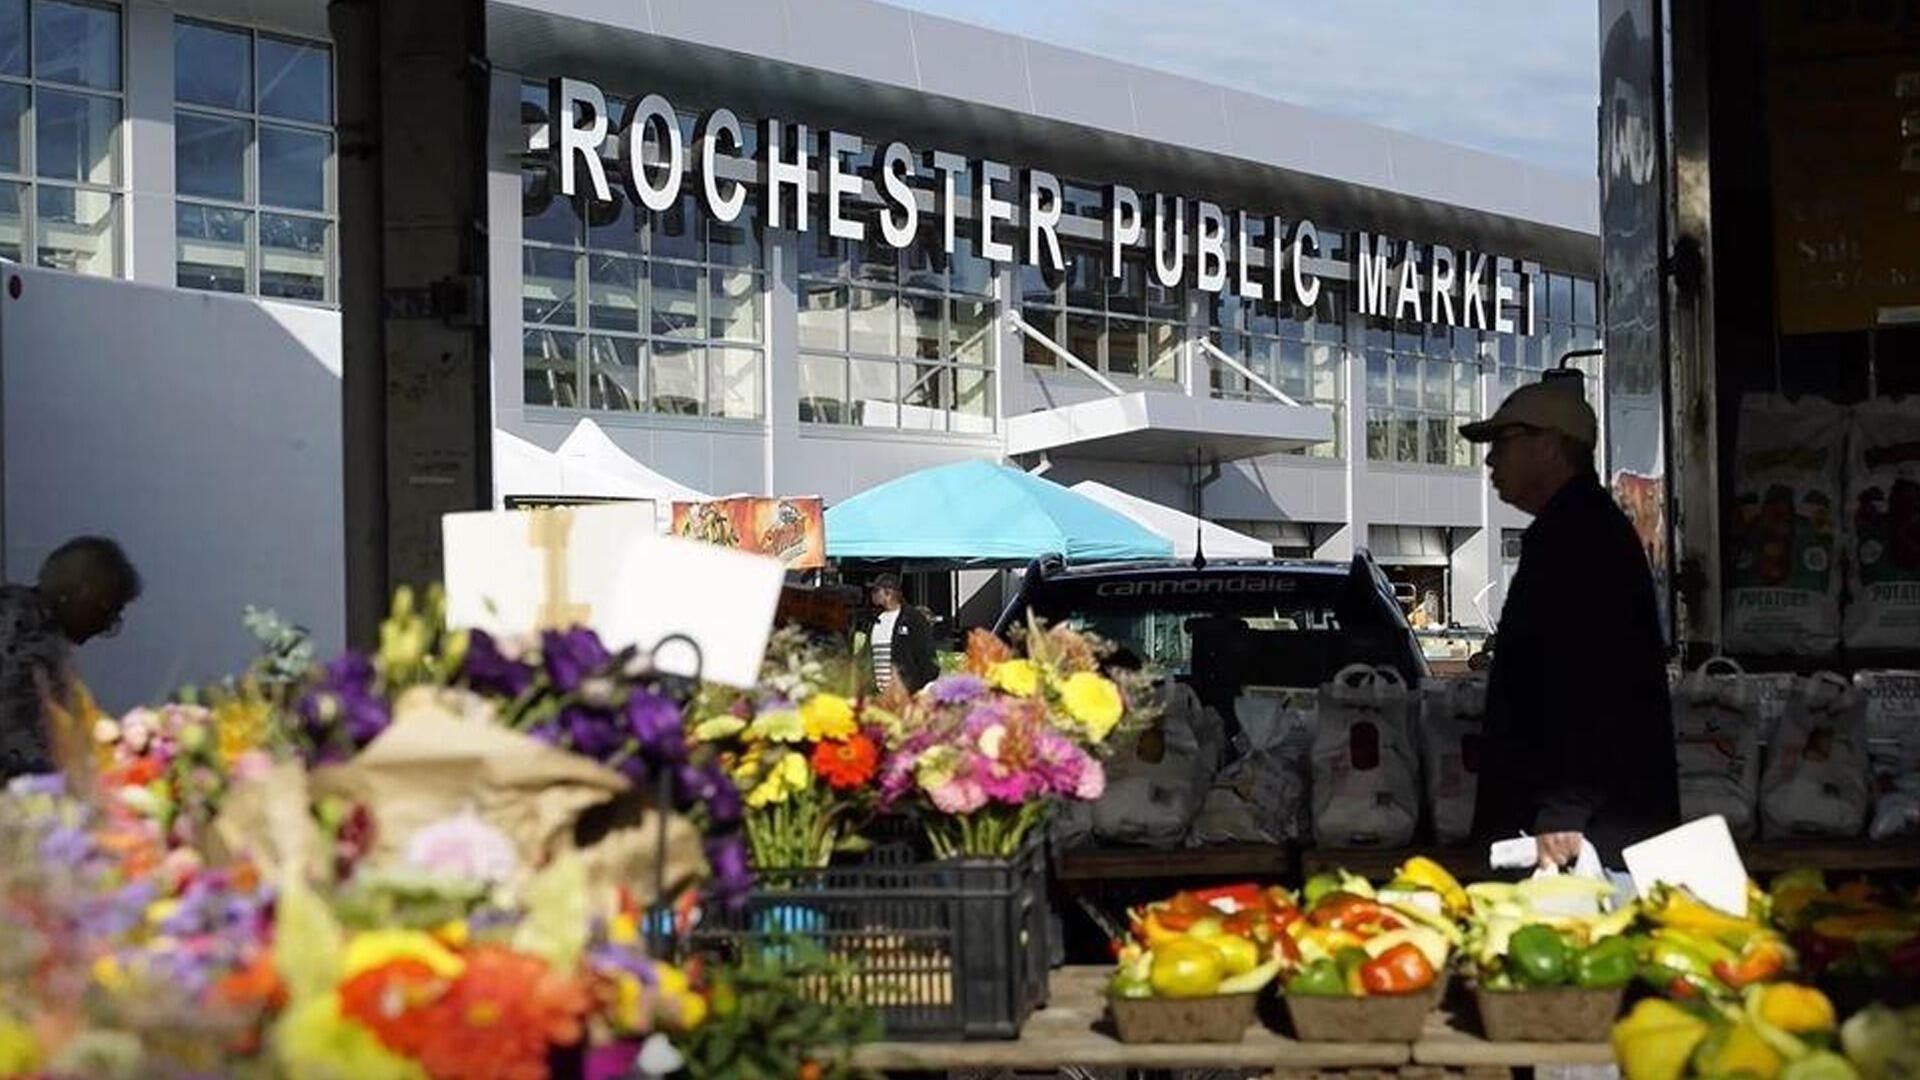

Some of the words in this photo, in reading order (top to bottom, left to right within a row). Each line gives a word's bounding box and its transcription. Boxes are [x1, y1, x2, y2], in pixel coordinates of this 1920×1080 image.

[558, 76, 1064, 270] ROCHESTER
[1111, 185, 1321, 307] PUBLIC
[1357, 231, 1541, 337] MARKET
[1096, 575, 1297, 597] cannondale
